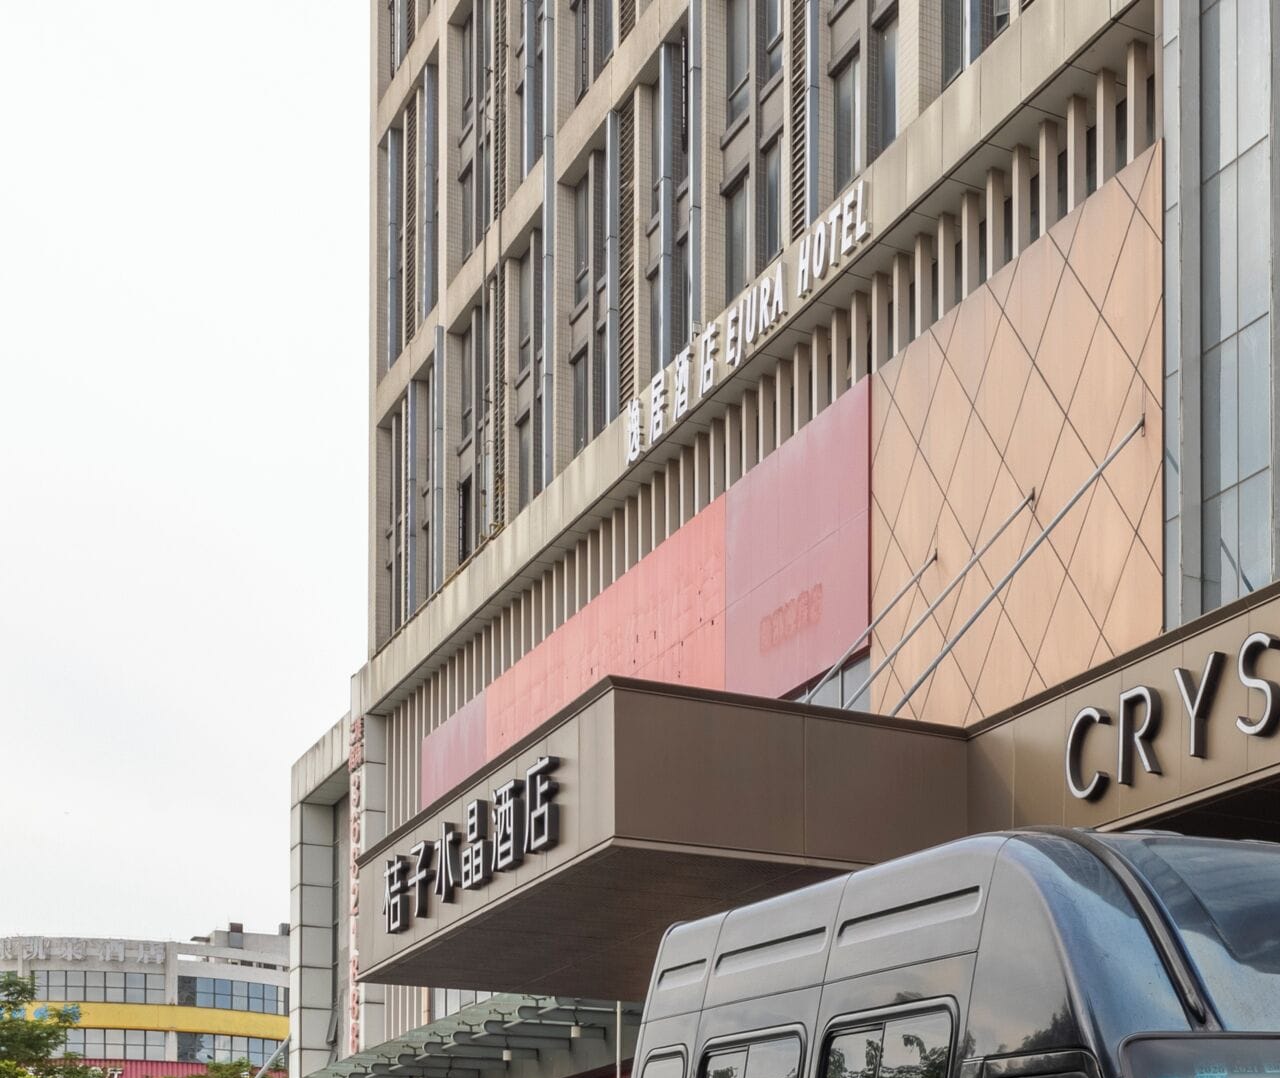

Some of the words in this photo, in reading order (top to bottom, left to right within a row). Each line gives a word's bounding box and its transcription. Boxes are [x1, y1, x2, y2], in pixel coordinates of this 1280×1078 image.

[725, 262, 788, 367] EJURA
[797, 180, 870, 298] HOTEL
[383, 756, 558, 934] 桔子水晶酒店
